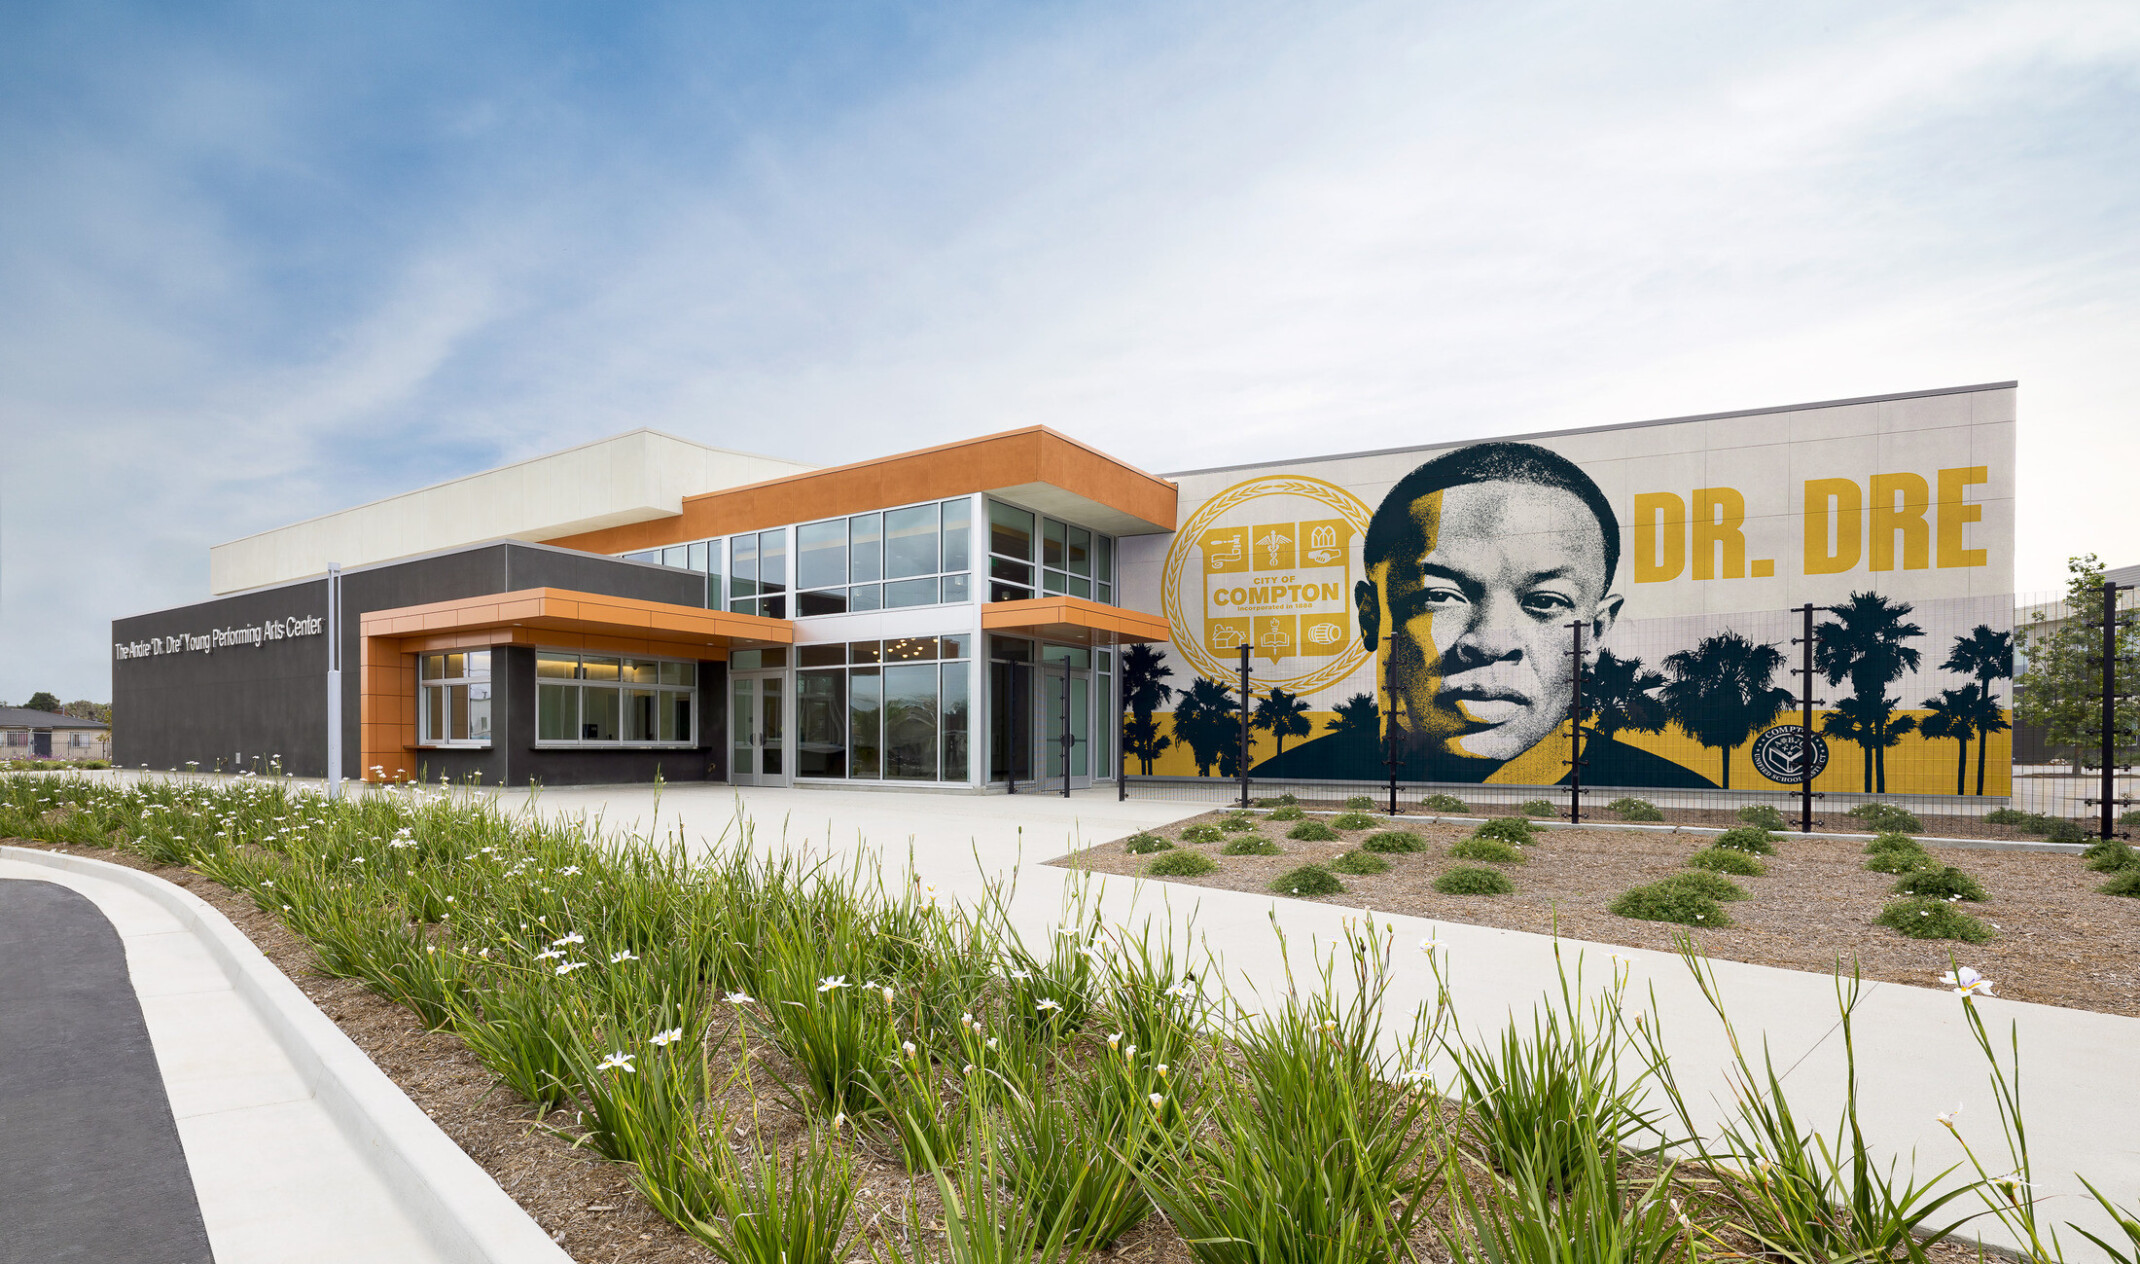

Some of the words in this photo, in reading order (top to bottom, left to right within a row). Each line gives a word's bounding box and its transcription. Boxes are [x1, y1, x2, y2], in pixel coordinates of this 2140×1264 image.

[1634, 487, 1774, 584] DR.
[1804, 465, 1988, 575] DRE
[1253, 576, 1278, 585] CITY
[1281, 575, 1296, 584] OF
[1213, 582, 1339, 606] COMPTON
[1237, 603, 1284, 611] Incorporated
[115, 643, 129, 660] The
[129, 640, 151, 658] Andre
[184, 633, 210, 654] Young
[212, 623, 262, 648] Performing
[264, 620, 285, 640] Arts
[286, 614, 322, 637] Center
[1765, 726, 1815, 739] COMPT
[1754, 753, 1772, 777] UNIFIED
